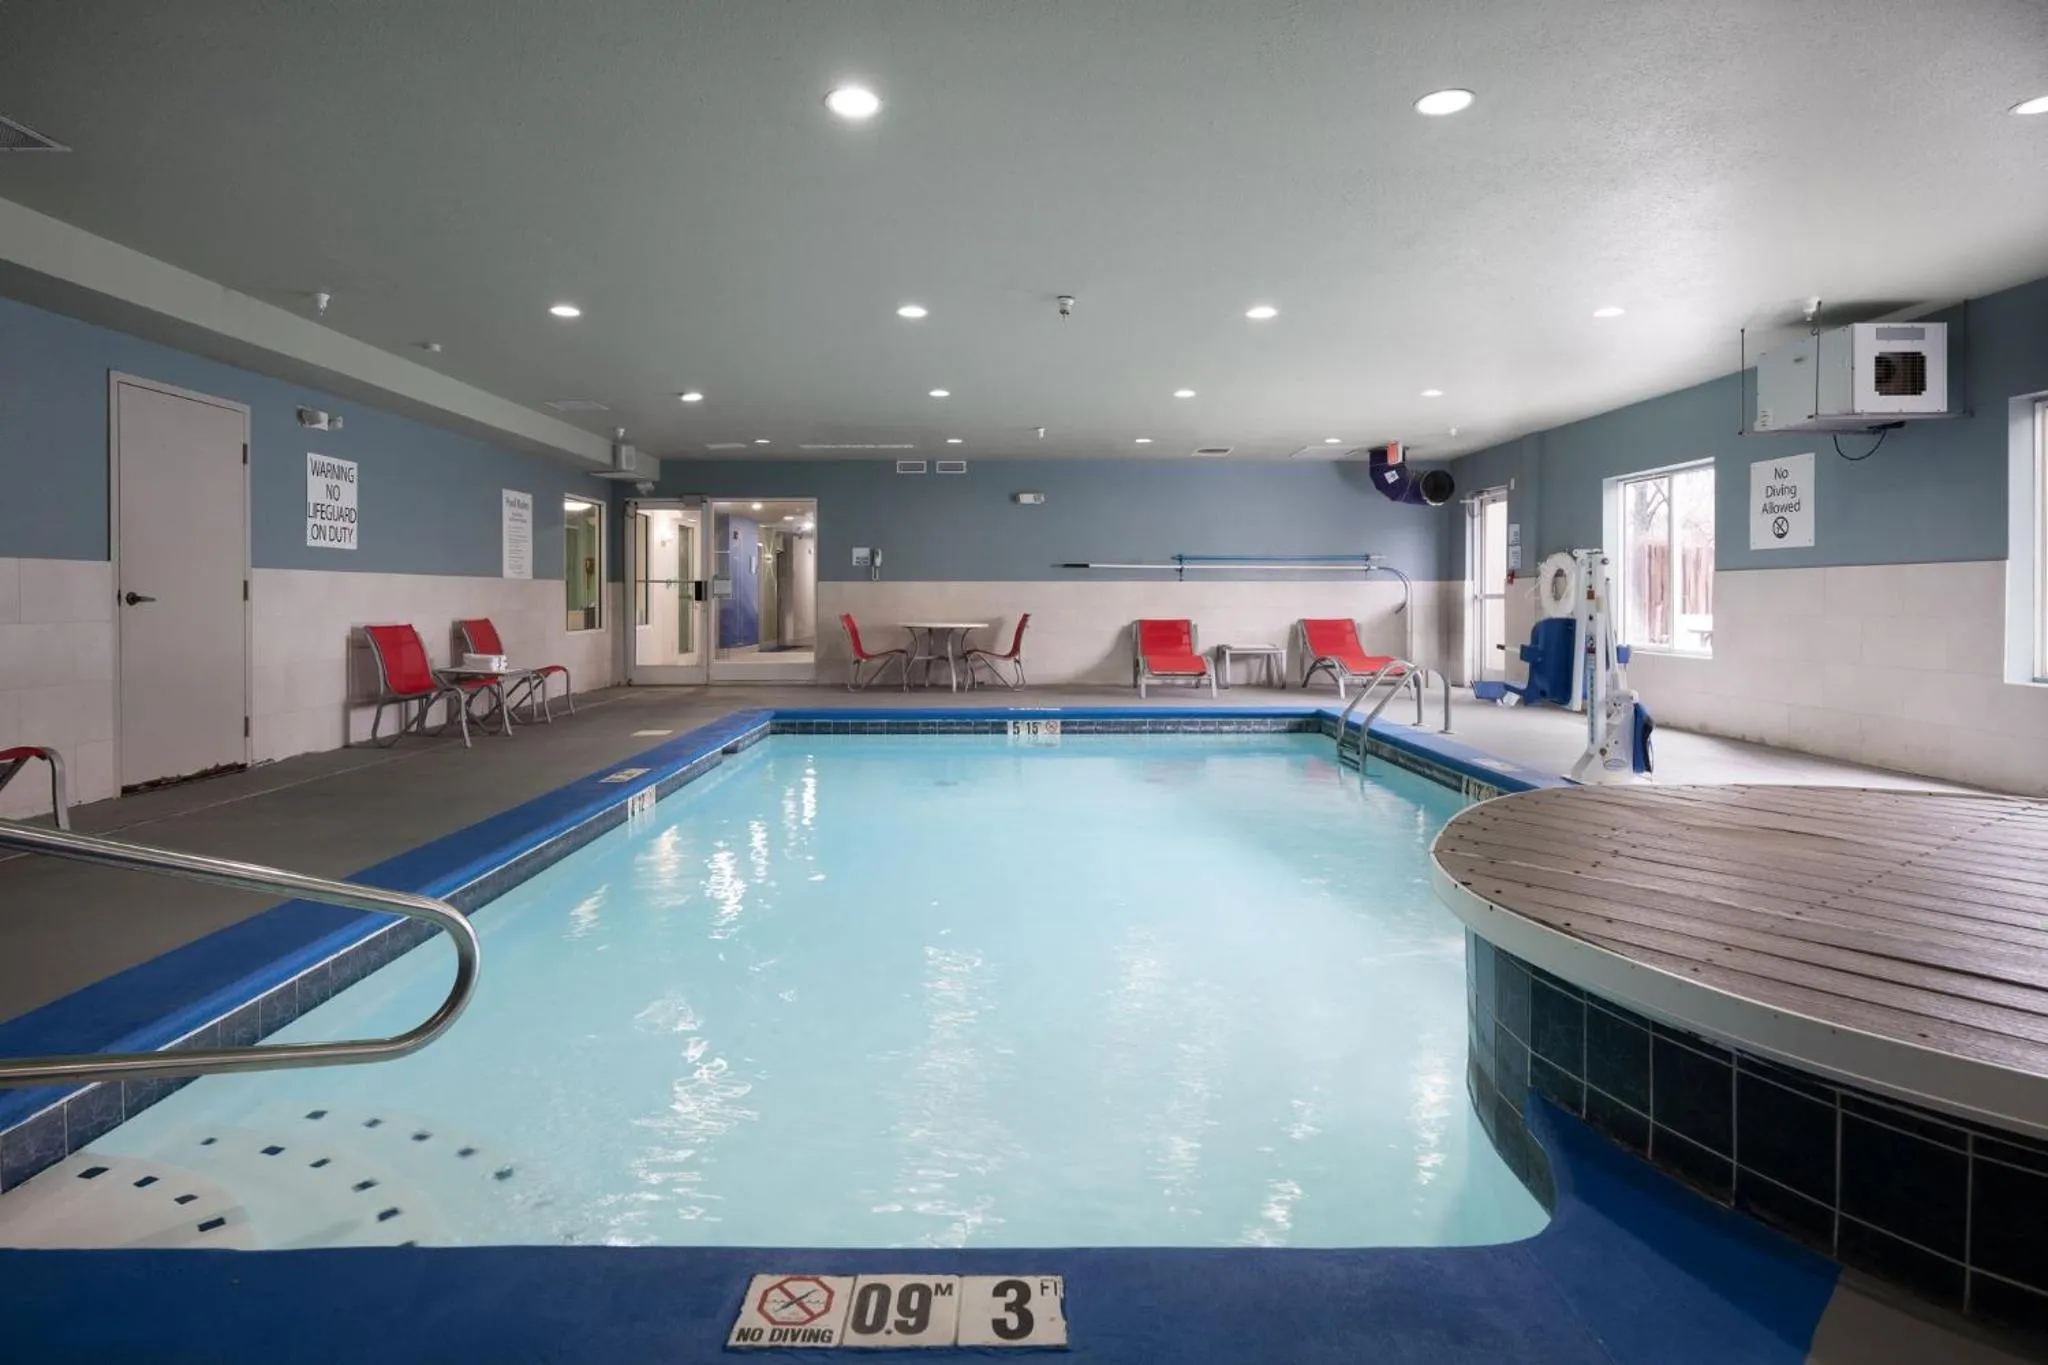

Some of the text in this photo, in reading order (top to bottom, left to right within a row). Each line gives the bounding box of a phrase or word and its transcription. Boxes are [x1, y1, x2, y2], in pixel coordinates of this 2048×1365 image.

[309, 456, 355, 483] WARNING
[1774, 466, 1789, 480] No
[325, 483, 341, 501] NO
[1765, 483, 1797, 499] Diving
[307, 500, 357, 524] LIFEGUARD
[1762, 499, 1801, 514] Allowed
[310, 522, 354, 544] ON DUTY
[851, 1282, 954, 1335] 0.9 M
[992, 1279, 1035, 1341] 3
[735, 1327, 834, 1344] NO DIVING
